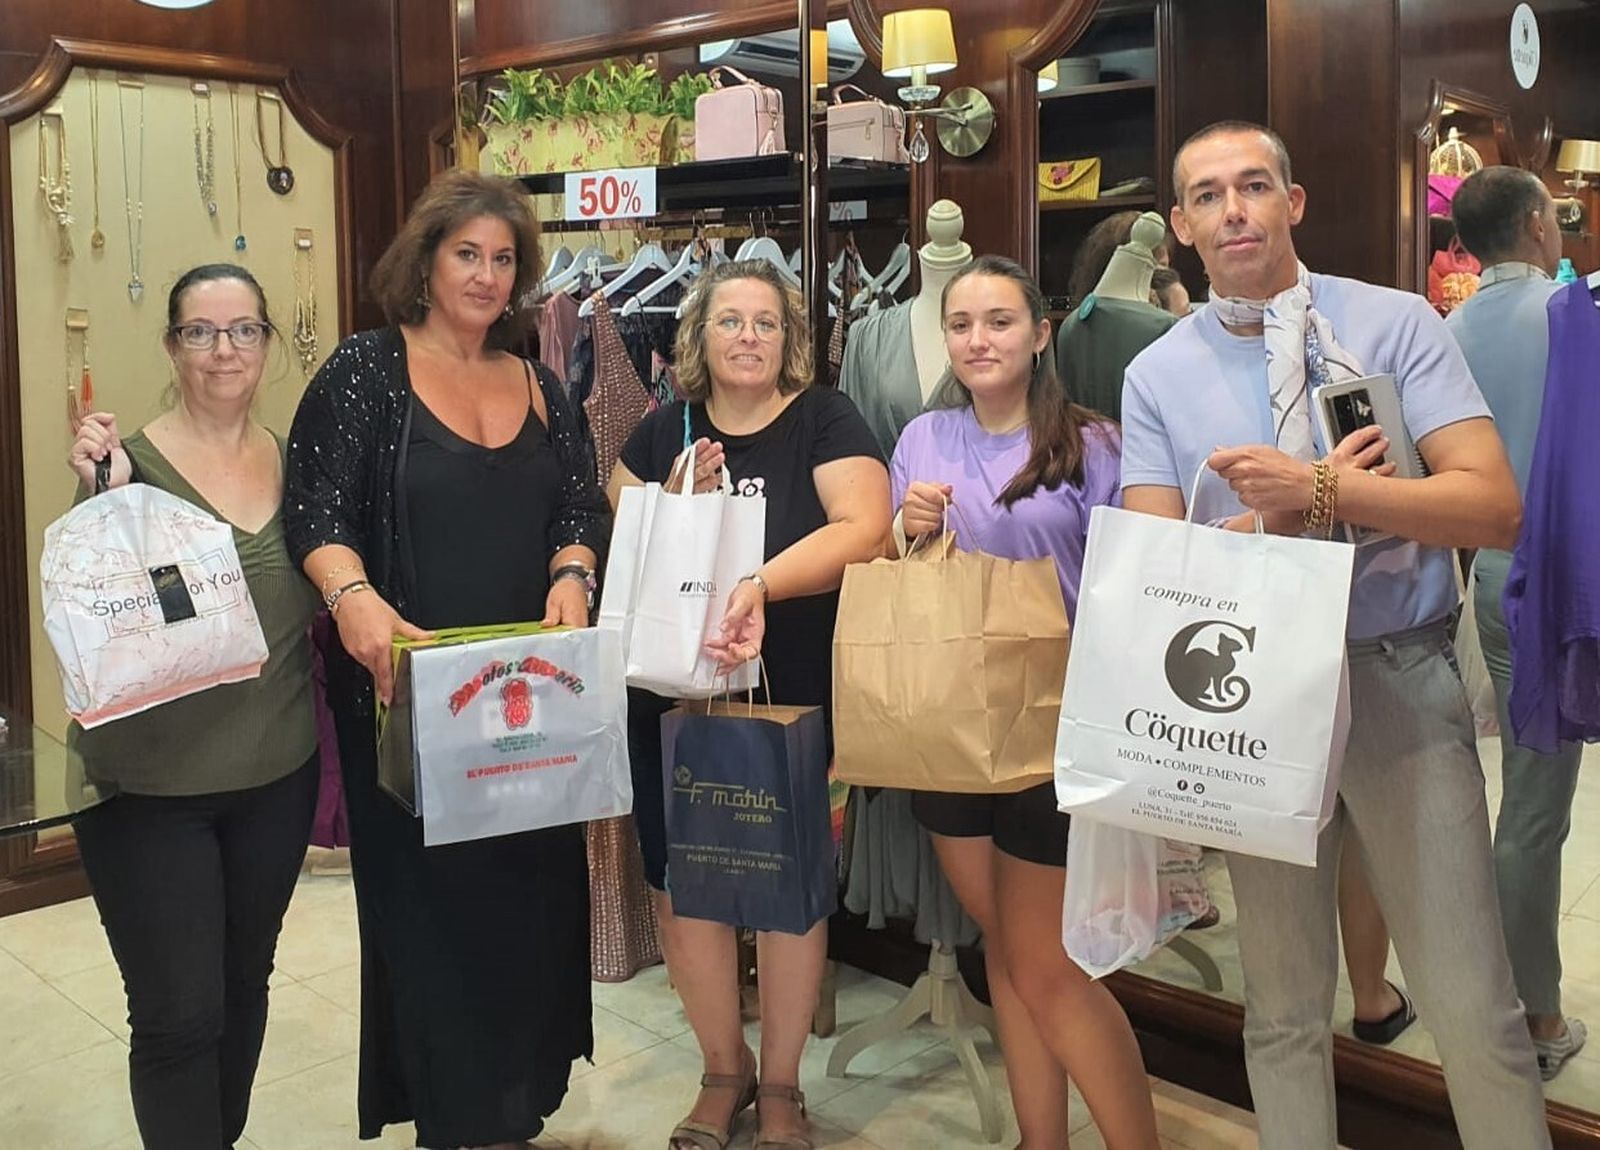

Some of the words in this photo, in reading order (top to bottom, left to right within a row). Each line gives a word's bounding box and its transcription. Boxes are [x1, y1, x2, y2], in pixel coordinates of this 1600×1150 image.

[579, 176, 641, 216] 50%
[93, 591, 160, 617] Specia
[189, 582, 205, 596] or
[206, 569, 241, 590] You
[1144, 585, 1212, 608] compra
[1217, 600, 1239, 613] en
[1125, 708, 1267, 760] Cöquette
[1117, 748, 1152, 765] MODA
[1164, 759, 1266, 787] COMPLEMENTOS
